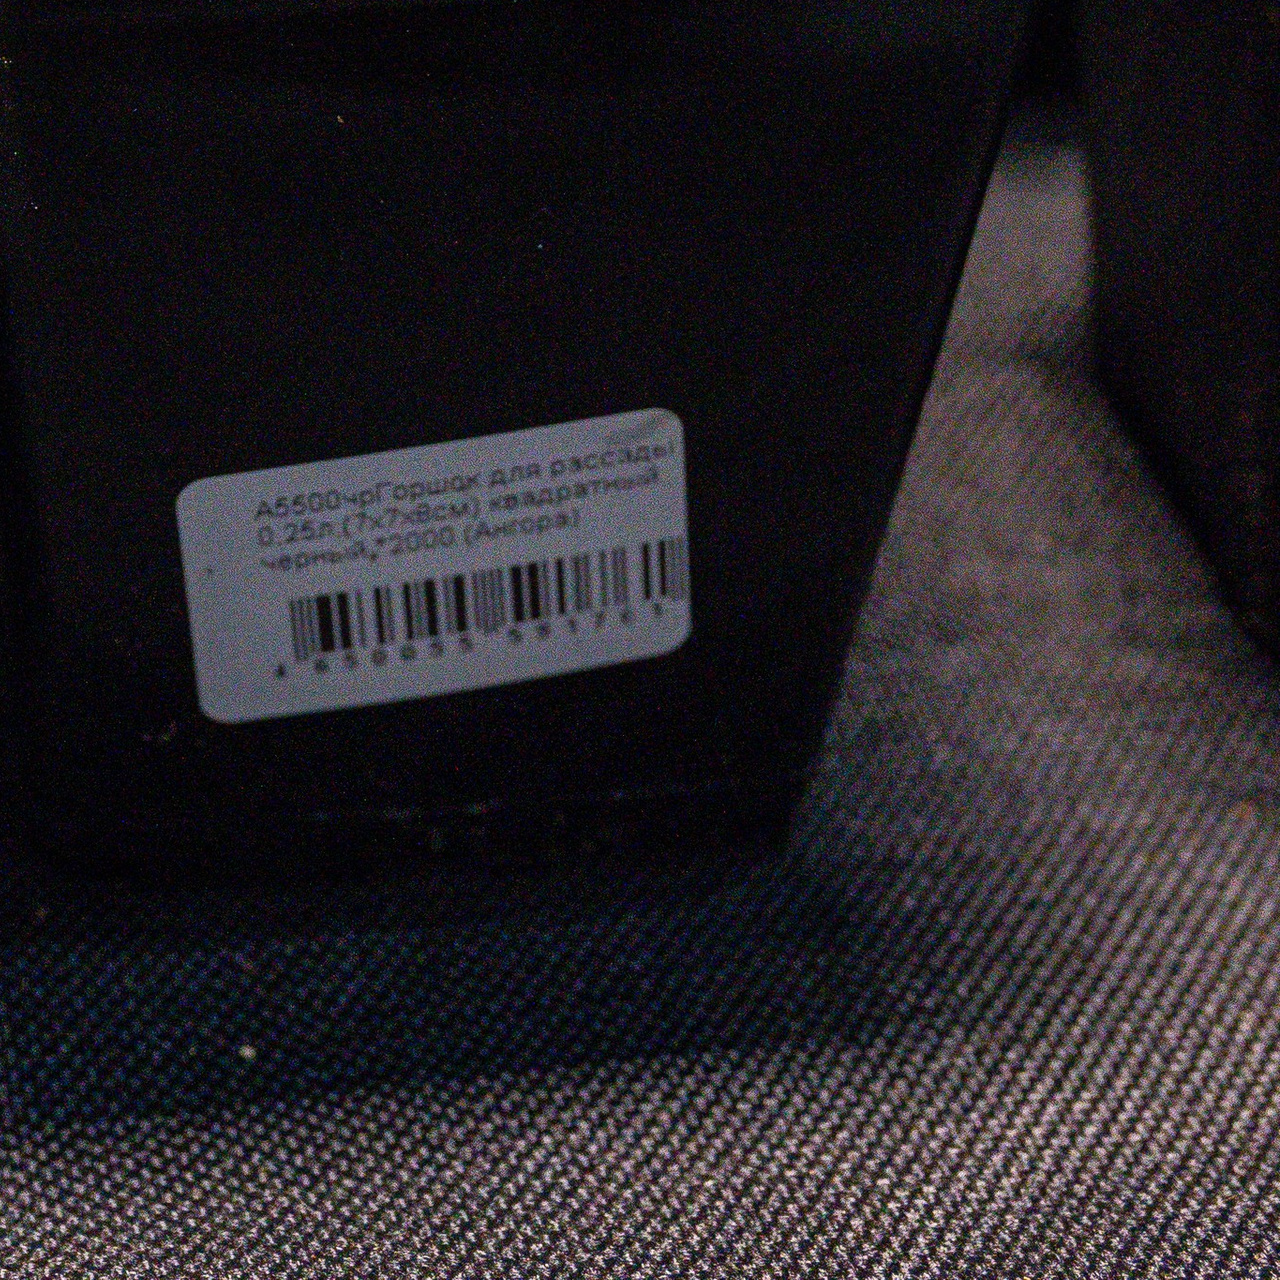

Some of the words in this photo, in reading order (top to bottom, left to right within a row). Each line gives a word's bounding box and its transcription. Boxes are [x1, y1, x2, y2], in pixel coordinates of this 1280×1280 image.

[488, 461, 541, 487] для
[550, 442, 675, 478] рассады
[489, 467, 658, 514] квадратный
[463, 510, 580, 546] (Ангора)
